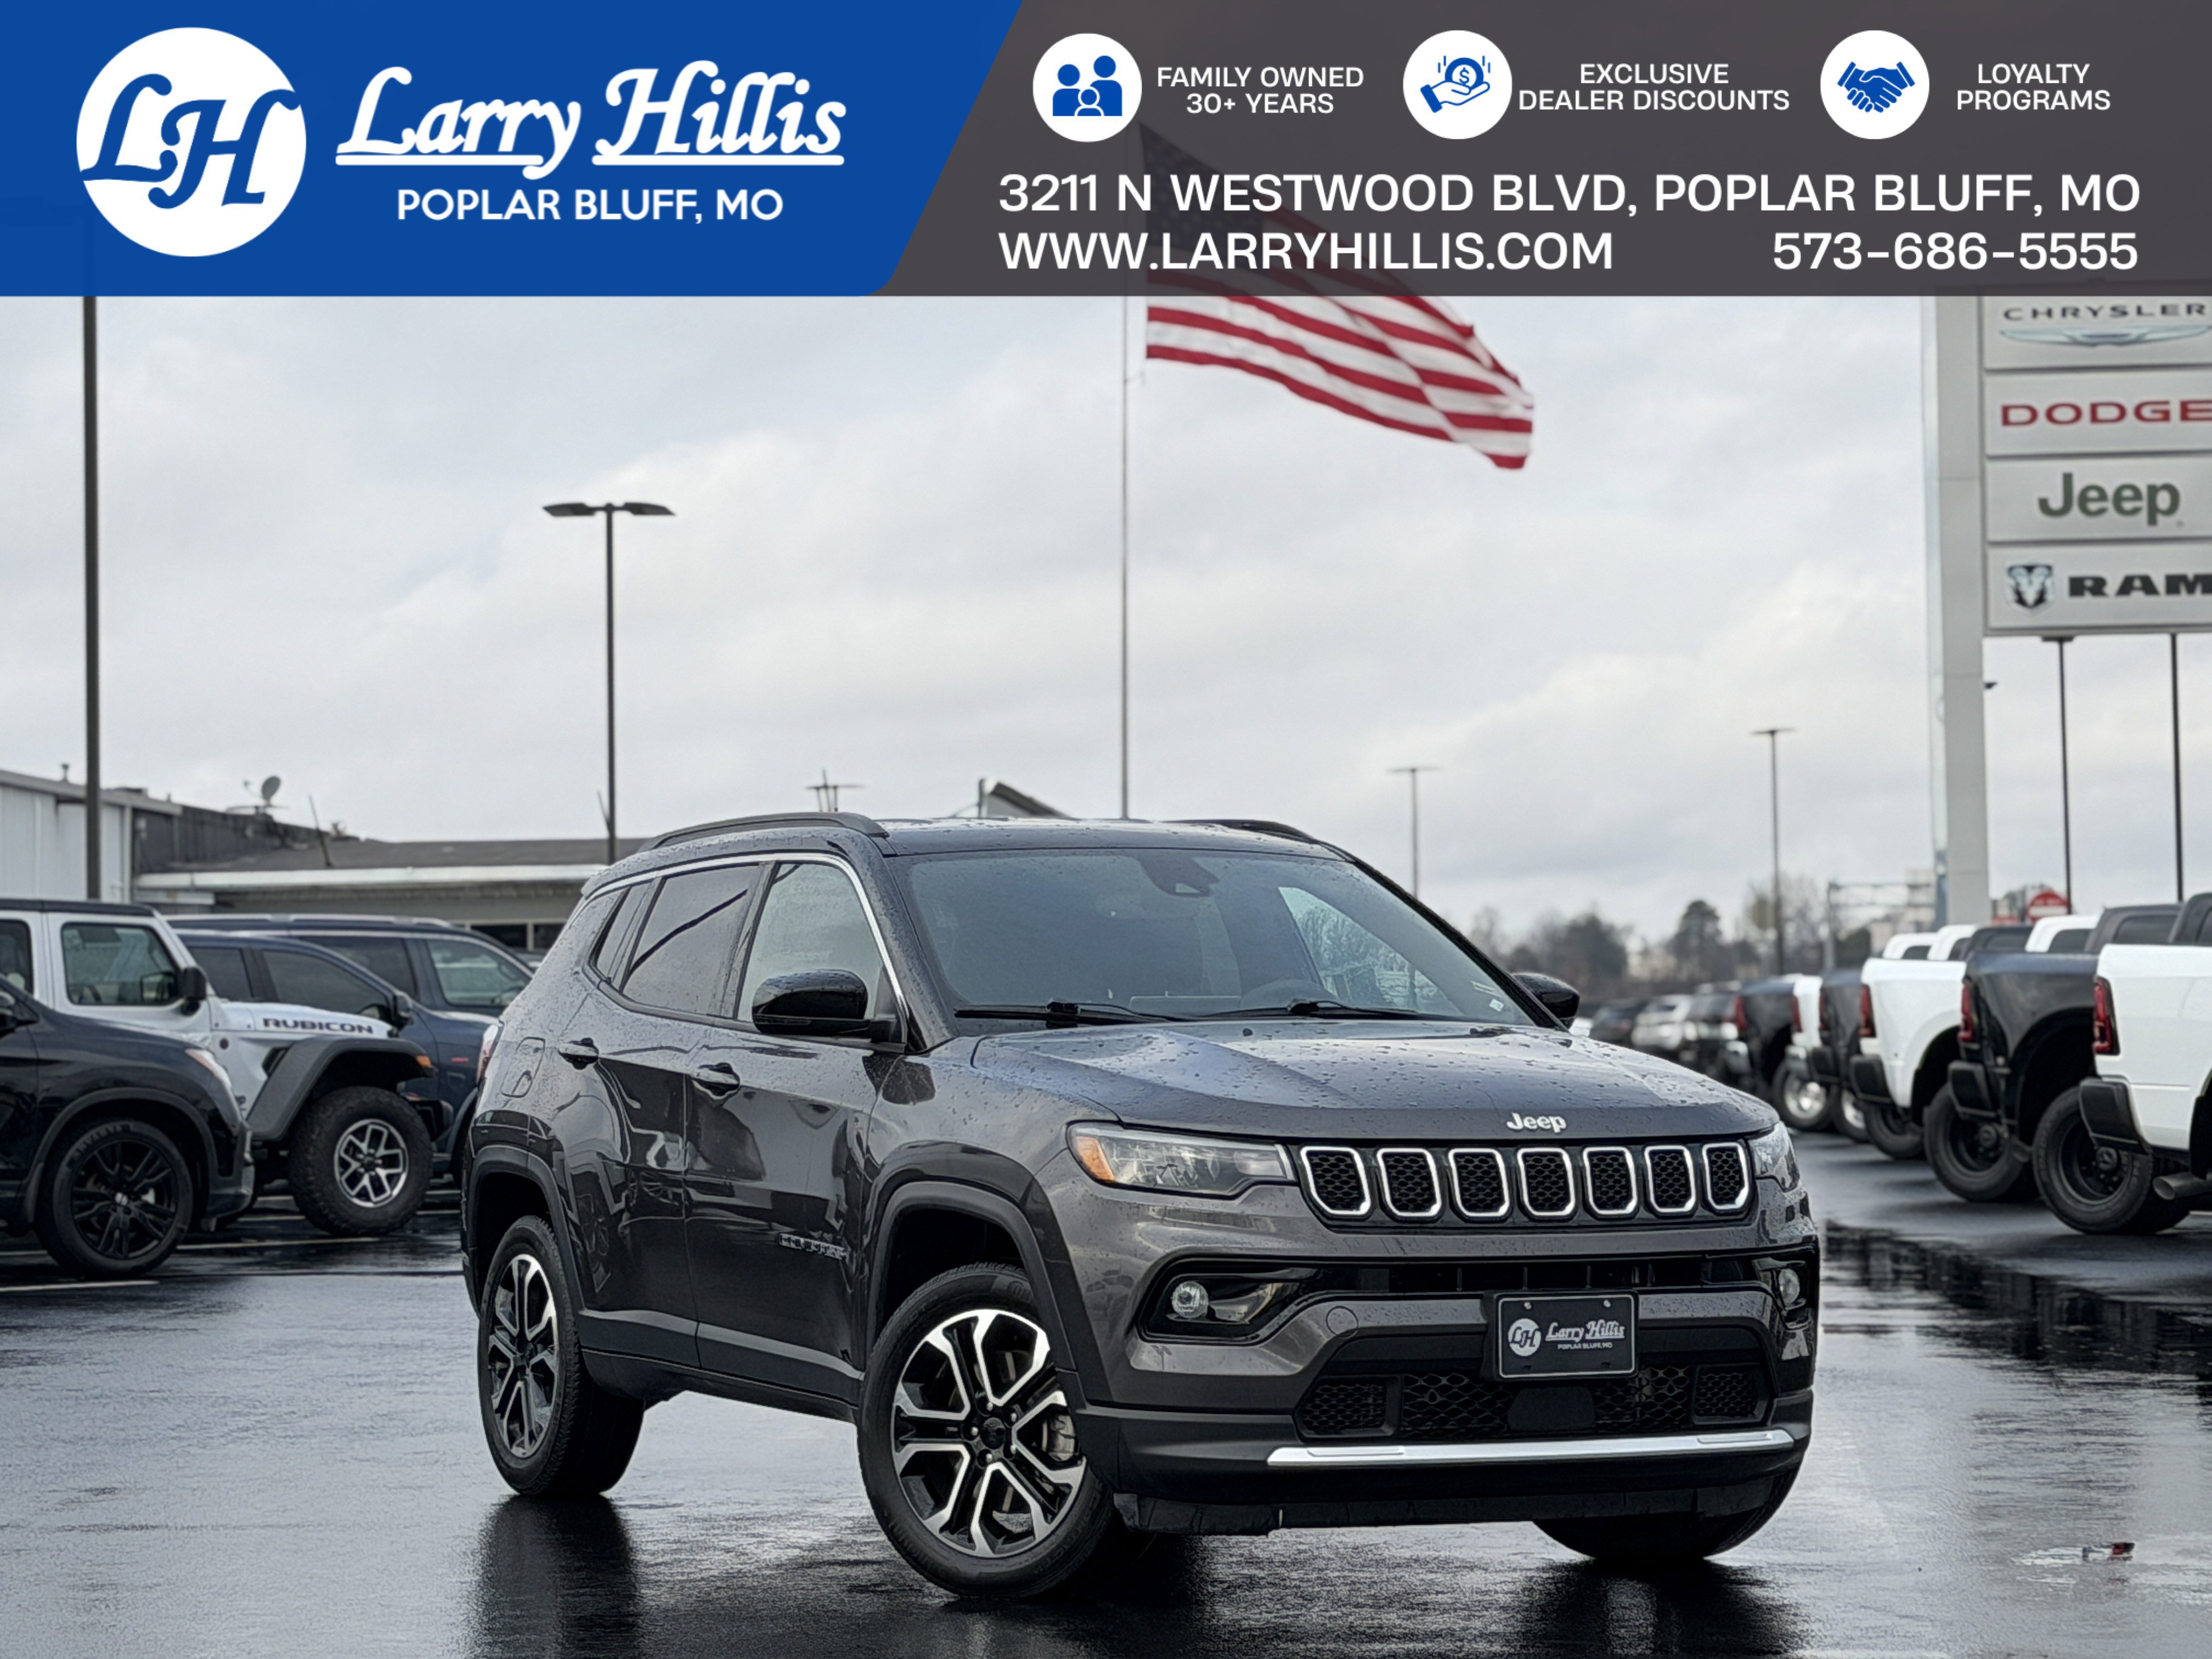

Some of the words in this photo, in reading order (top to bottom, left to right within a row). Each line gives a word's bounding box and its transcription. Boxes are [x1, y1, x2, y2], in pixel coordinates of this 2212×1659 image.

[2004, 303, 2206, 321] CHRYSLER
[2001, 400, 2212, 426] DODGE
[2038, 472, 2181, 526] Jeep
[2068, 574, 2212, 597] RAM
[263, 1018, 374, 1034] RUBICON
[1506, 1112, 1566, 1133] Jeep
[1545, 1322, 1584, 1342] Larry
[1585, 1319, 1625, 1339] Hillis
